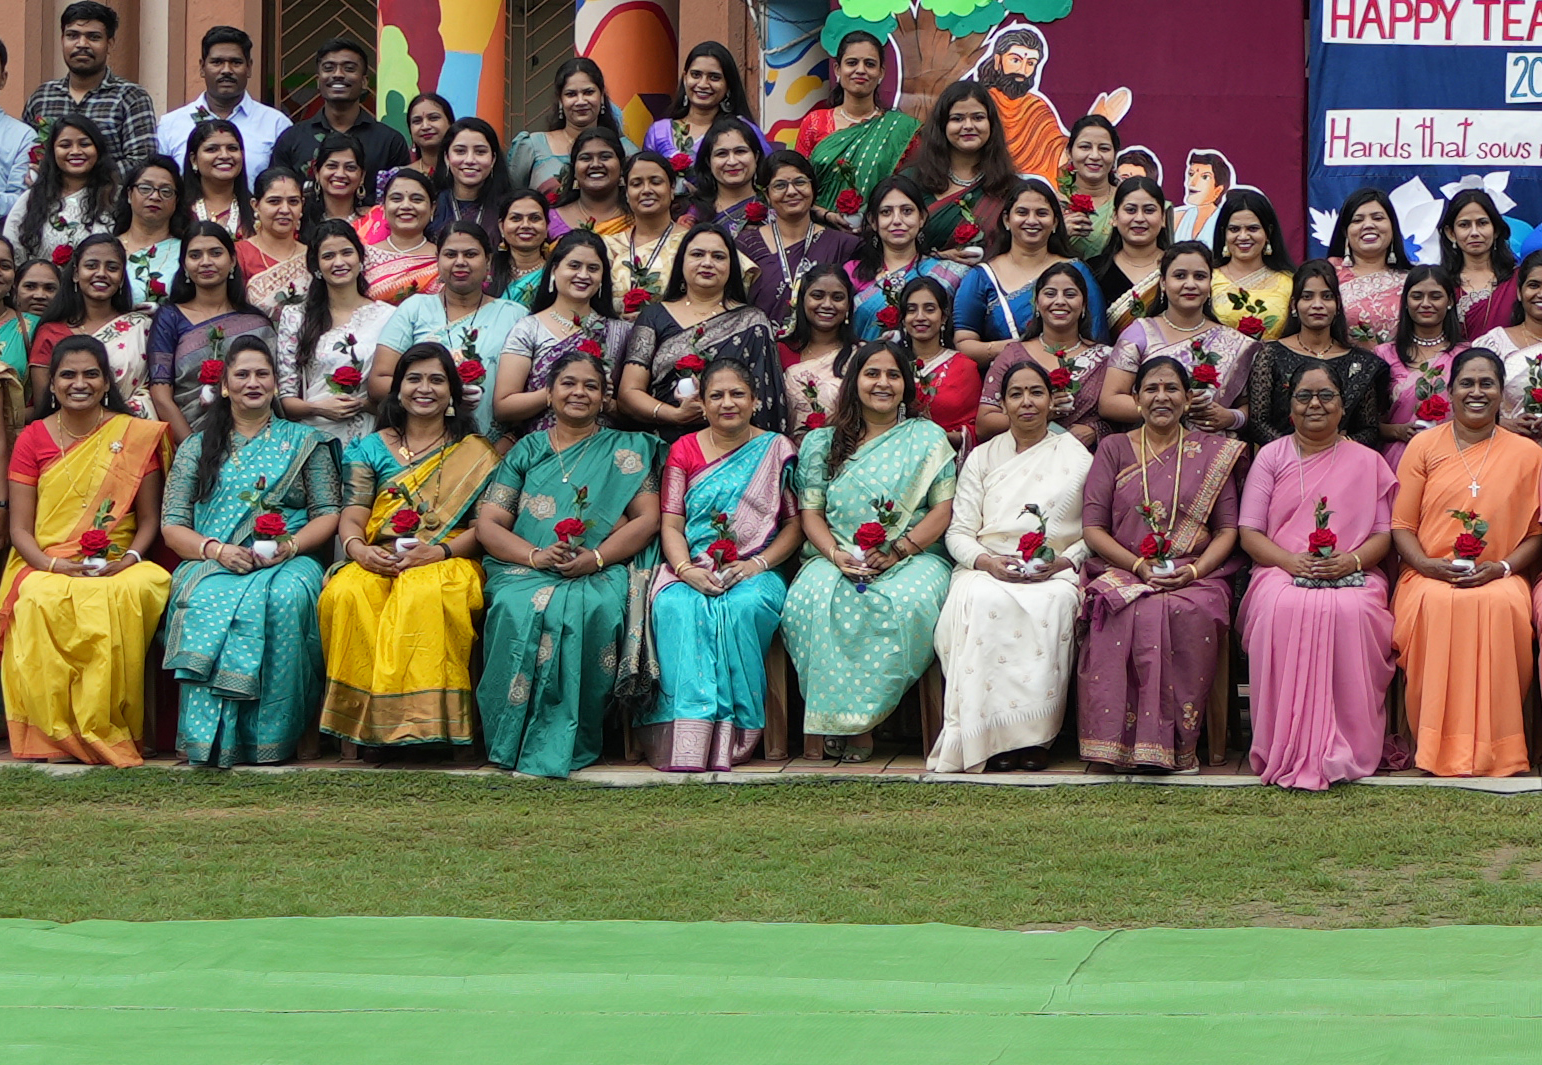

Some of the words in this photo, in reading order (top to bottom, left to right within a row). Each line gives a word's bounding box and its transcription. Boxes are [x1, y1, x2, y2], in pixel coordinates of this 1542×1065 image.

[1328, 117, 1411, 159] Hands
[1414, 116, 1474, 159] that
[1476, 139, 1532, 159] sows
